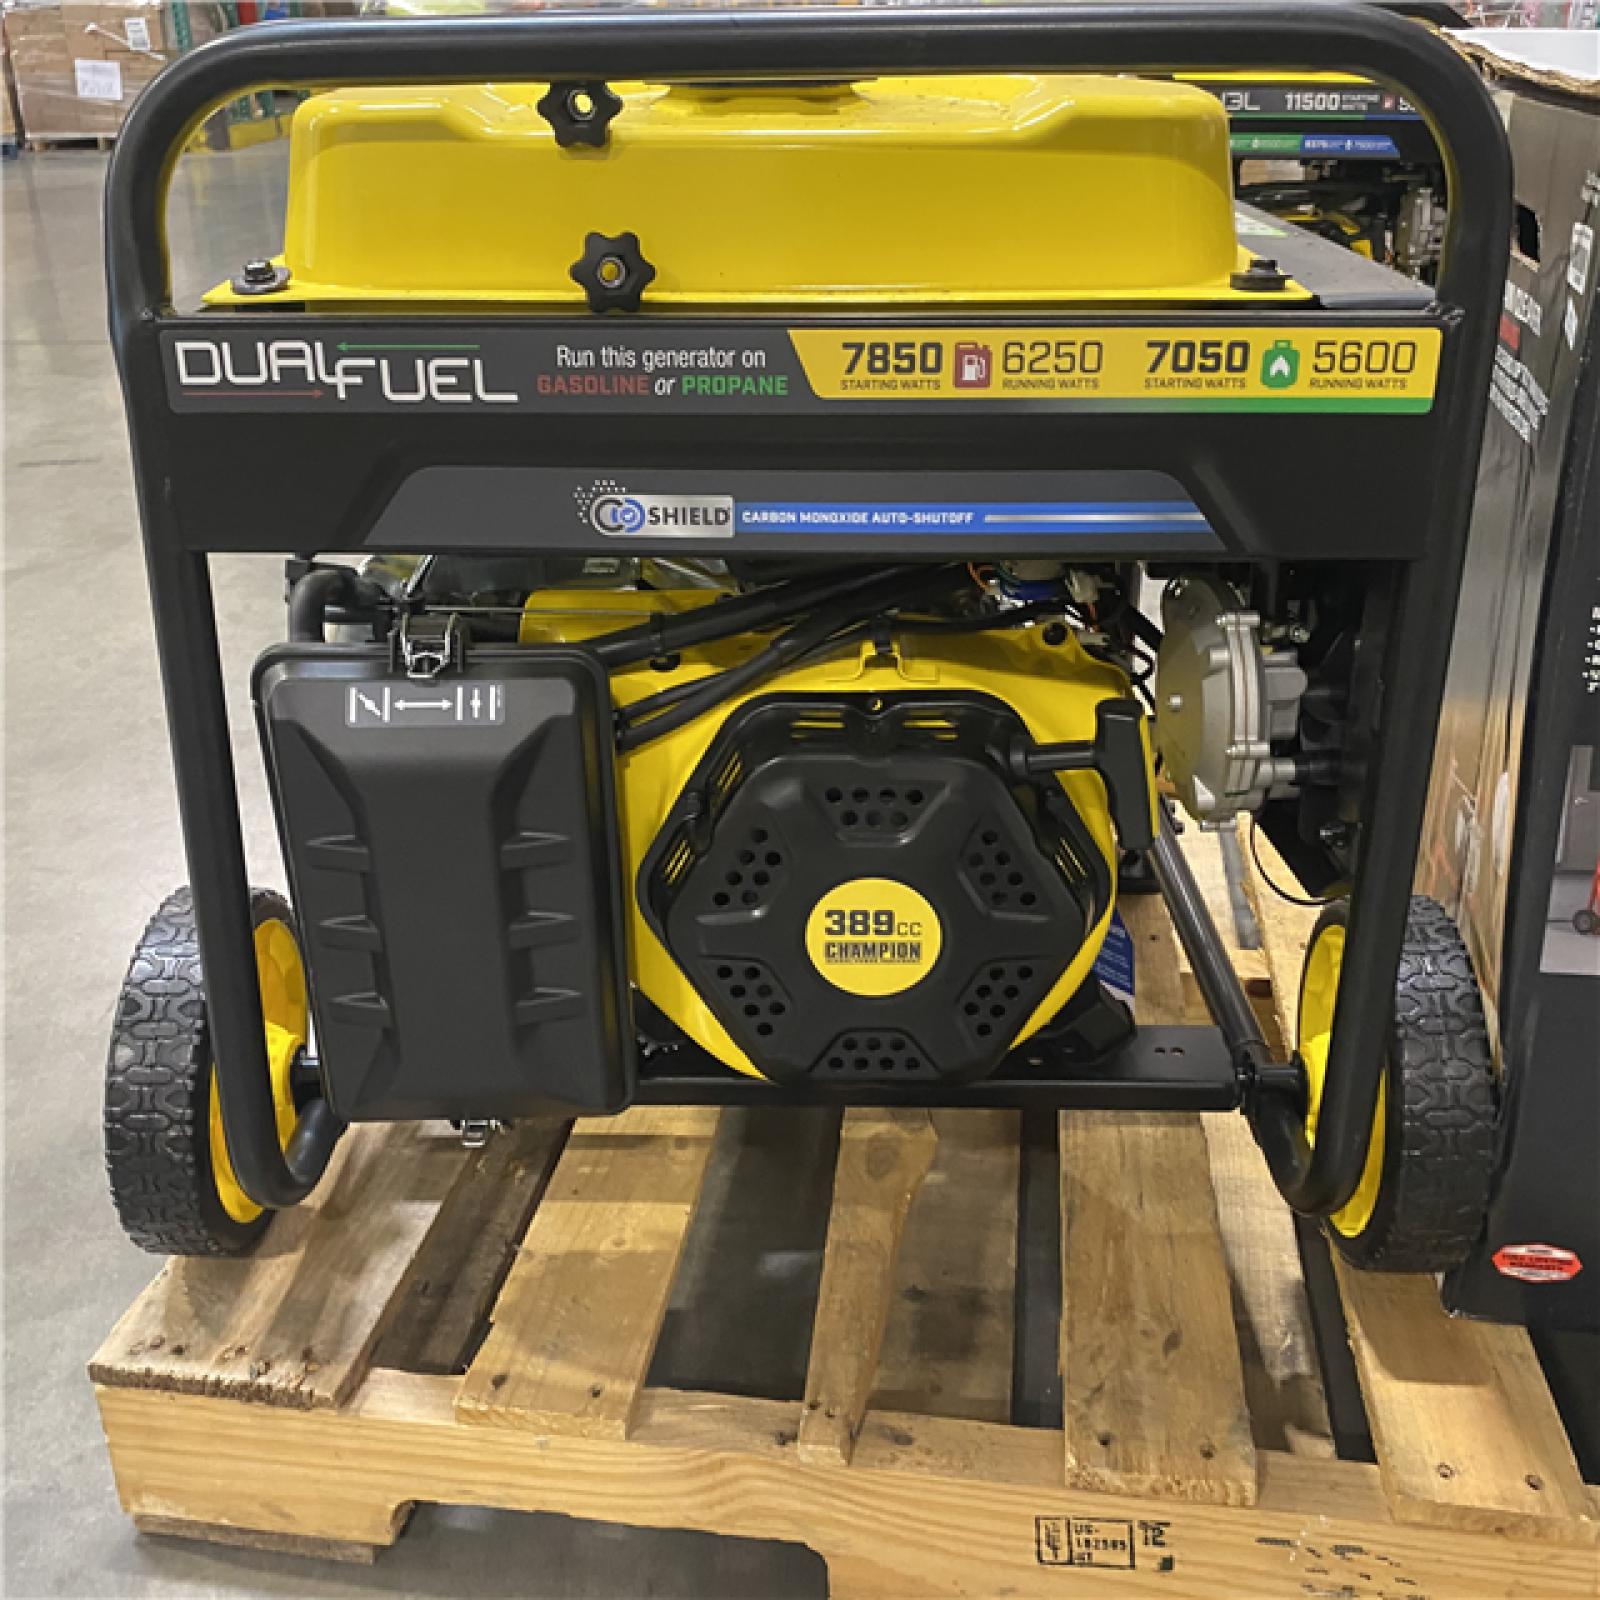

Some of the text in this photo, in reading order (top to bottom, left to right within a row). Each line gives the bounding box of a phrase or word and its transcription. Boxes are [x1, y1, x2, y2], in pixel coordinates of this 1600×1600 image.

[1285, 92, 1340, 111] 11500
[556, 345, 766, 373] Run this generator on
[841, 342, 943, 375] 7850
[1003, 340, 1103, 374] 6250
[1146, 341, 1250, 374] 7050
[1312, 340, 1418, 374] 5600
[174, 340, 519, 401] DUAL FUEL
[536, 375, 788, 396] GASOLINE or PROPANE
[840, 379, 941, 390] STARTING WATTS
[1002, 378, 1099, 390] RUNNING WATTS
[1144, 377, 1247, 389] STARTING WATTS
[1309, 377, 1408, 390] RUNNING WATTS
[648, 506, 732, 526] SHIELD
[742, 511, 974, 524] CARBON MONOXIDE AUTO-SHUTOFF
[825, 941, 922, 960] CHAMPION
